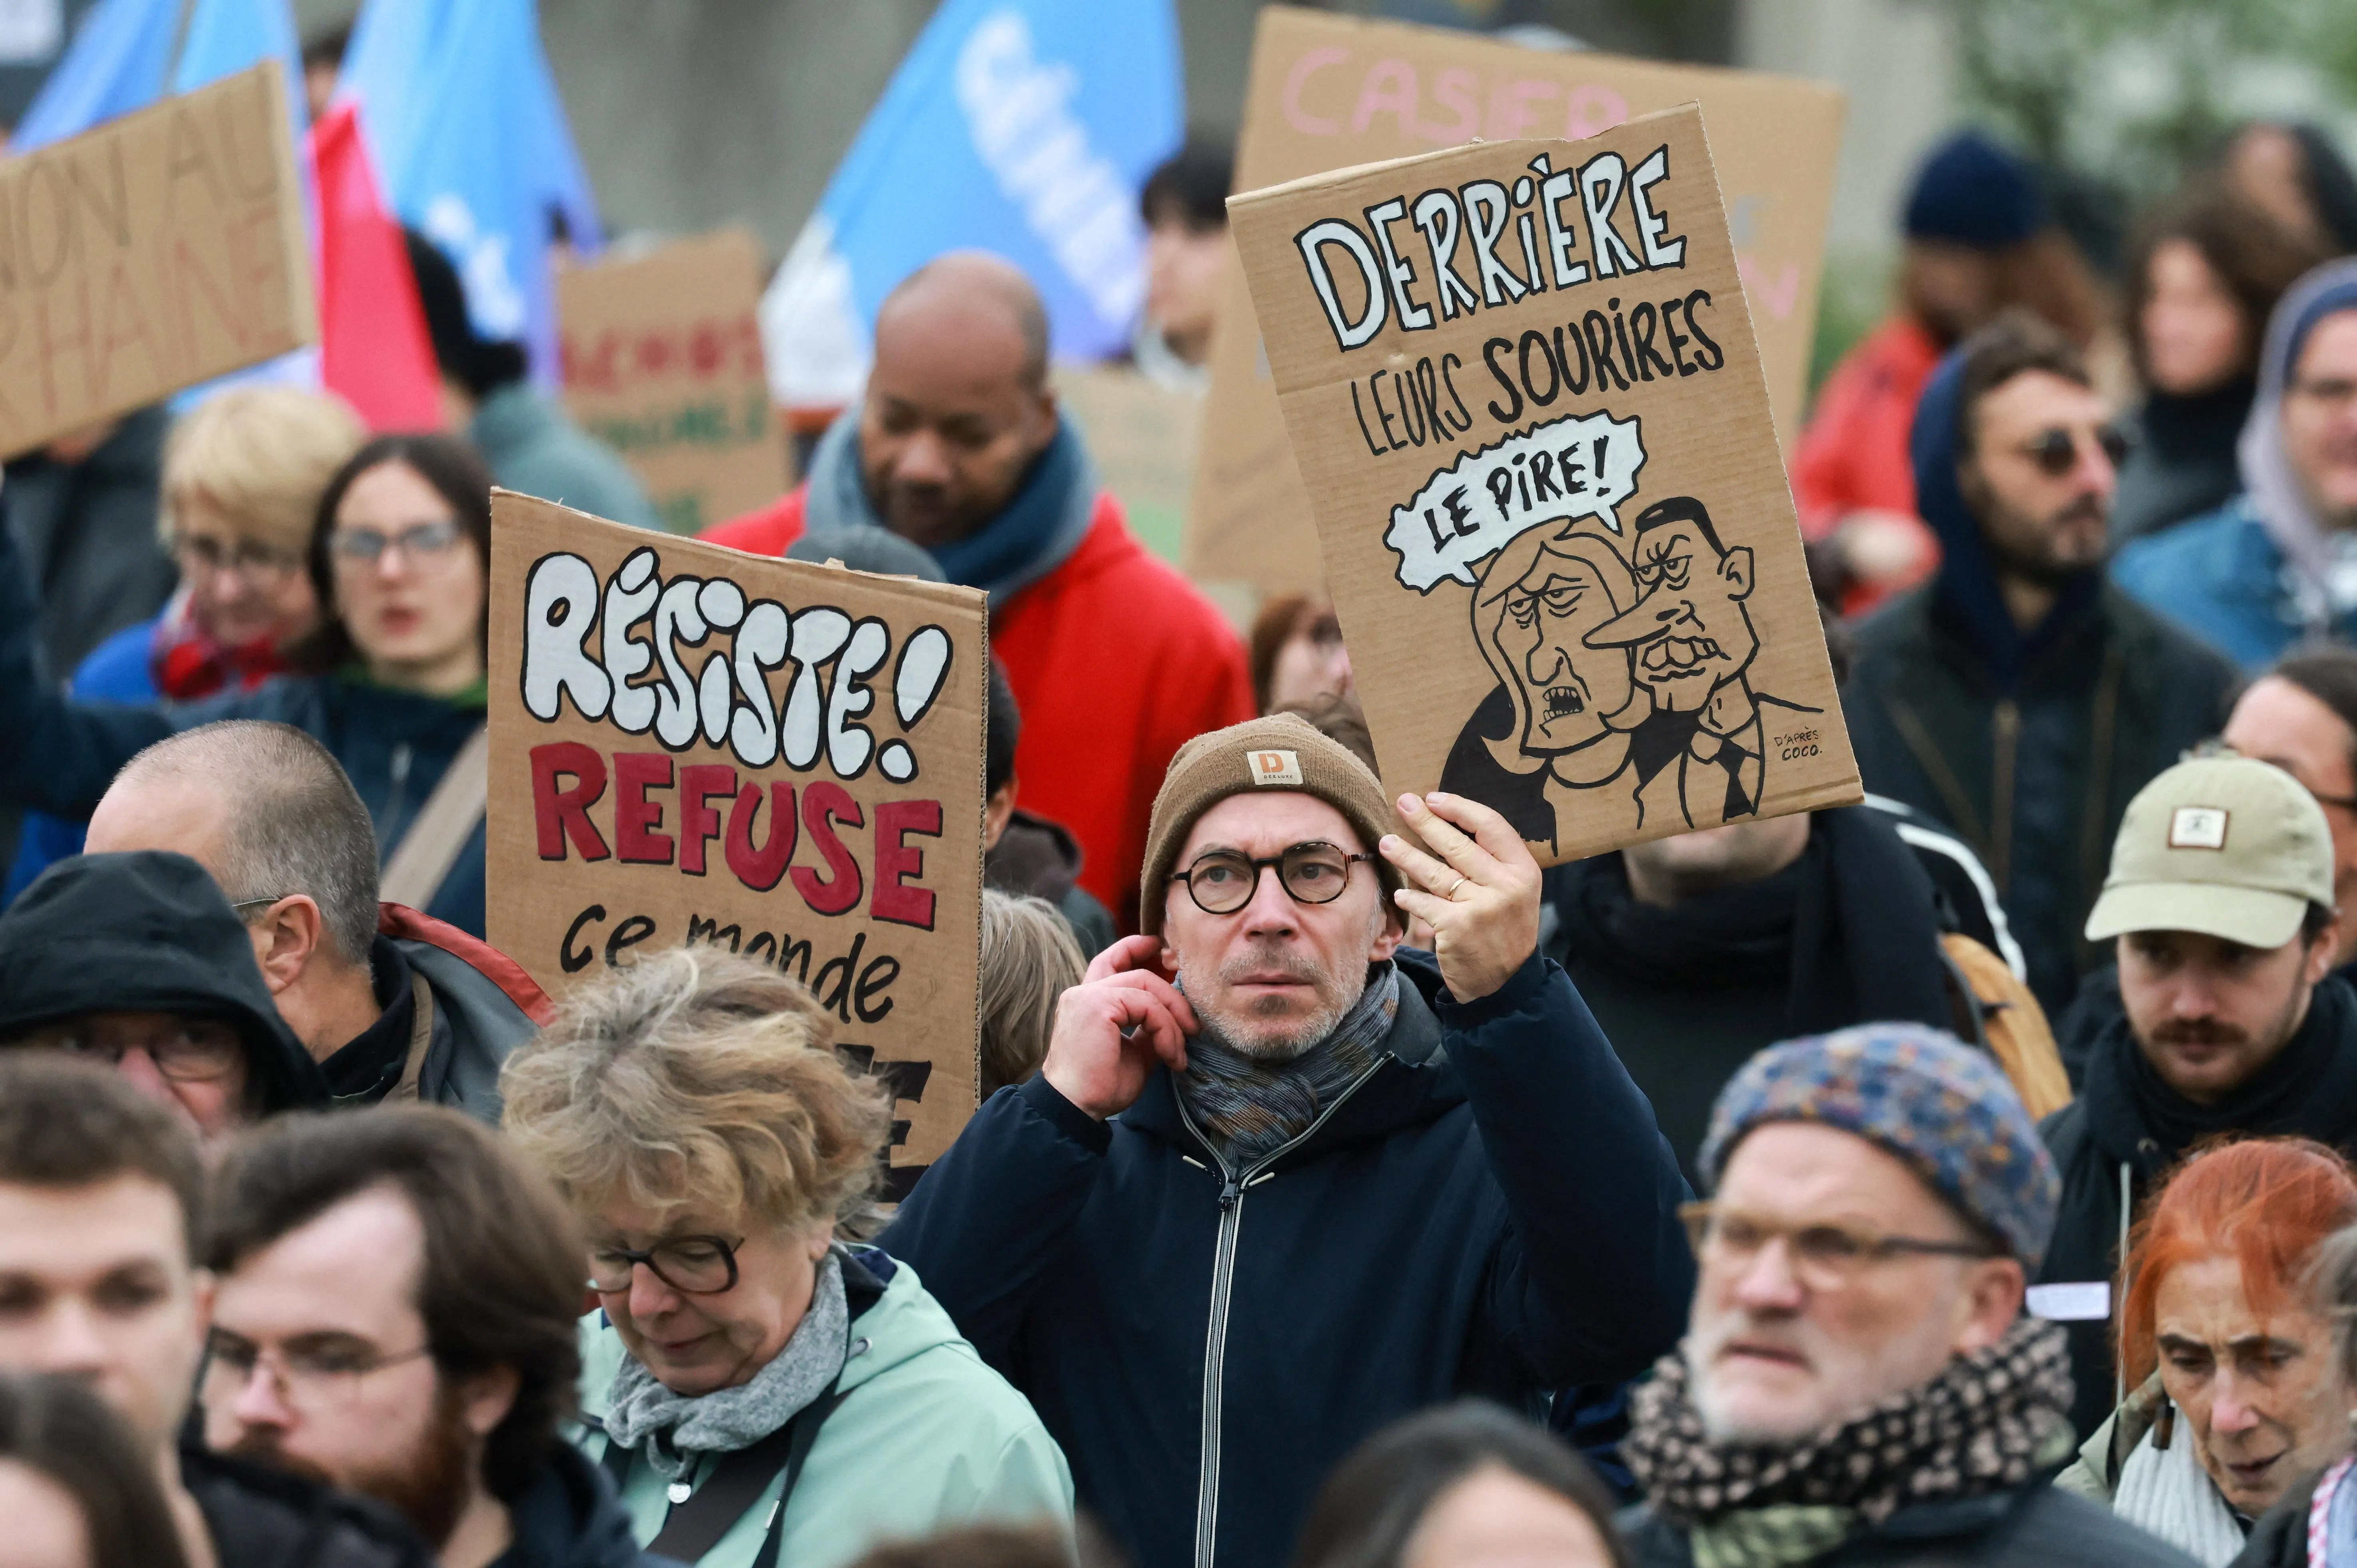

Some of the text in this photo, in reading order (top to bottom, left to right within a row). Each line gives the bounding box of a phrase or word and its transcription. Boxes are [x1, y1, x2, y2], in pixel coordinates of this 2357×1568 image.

[1351, 353, 1472, 456] LEURS
[1424, 485, 1479, 554] LE
[1774, 726, 1819, 746] D'APRÈS
[1782, 744, 1822, 760] COCO.
[530, 741, 942, 930] REFUSE
[560, 904, 656, 973] ce
